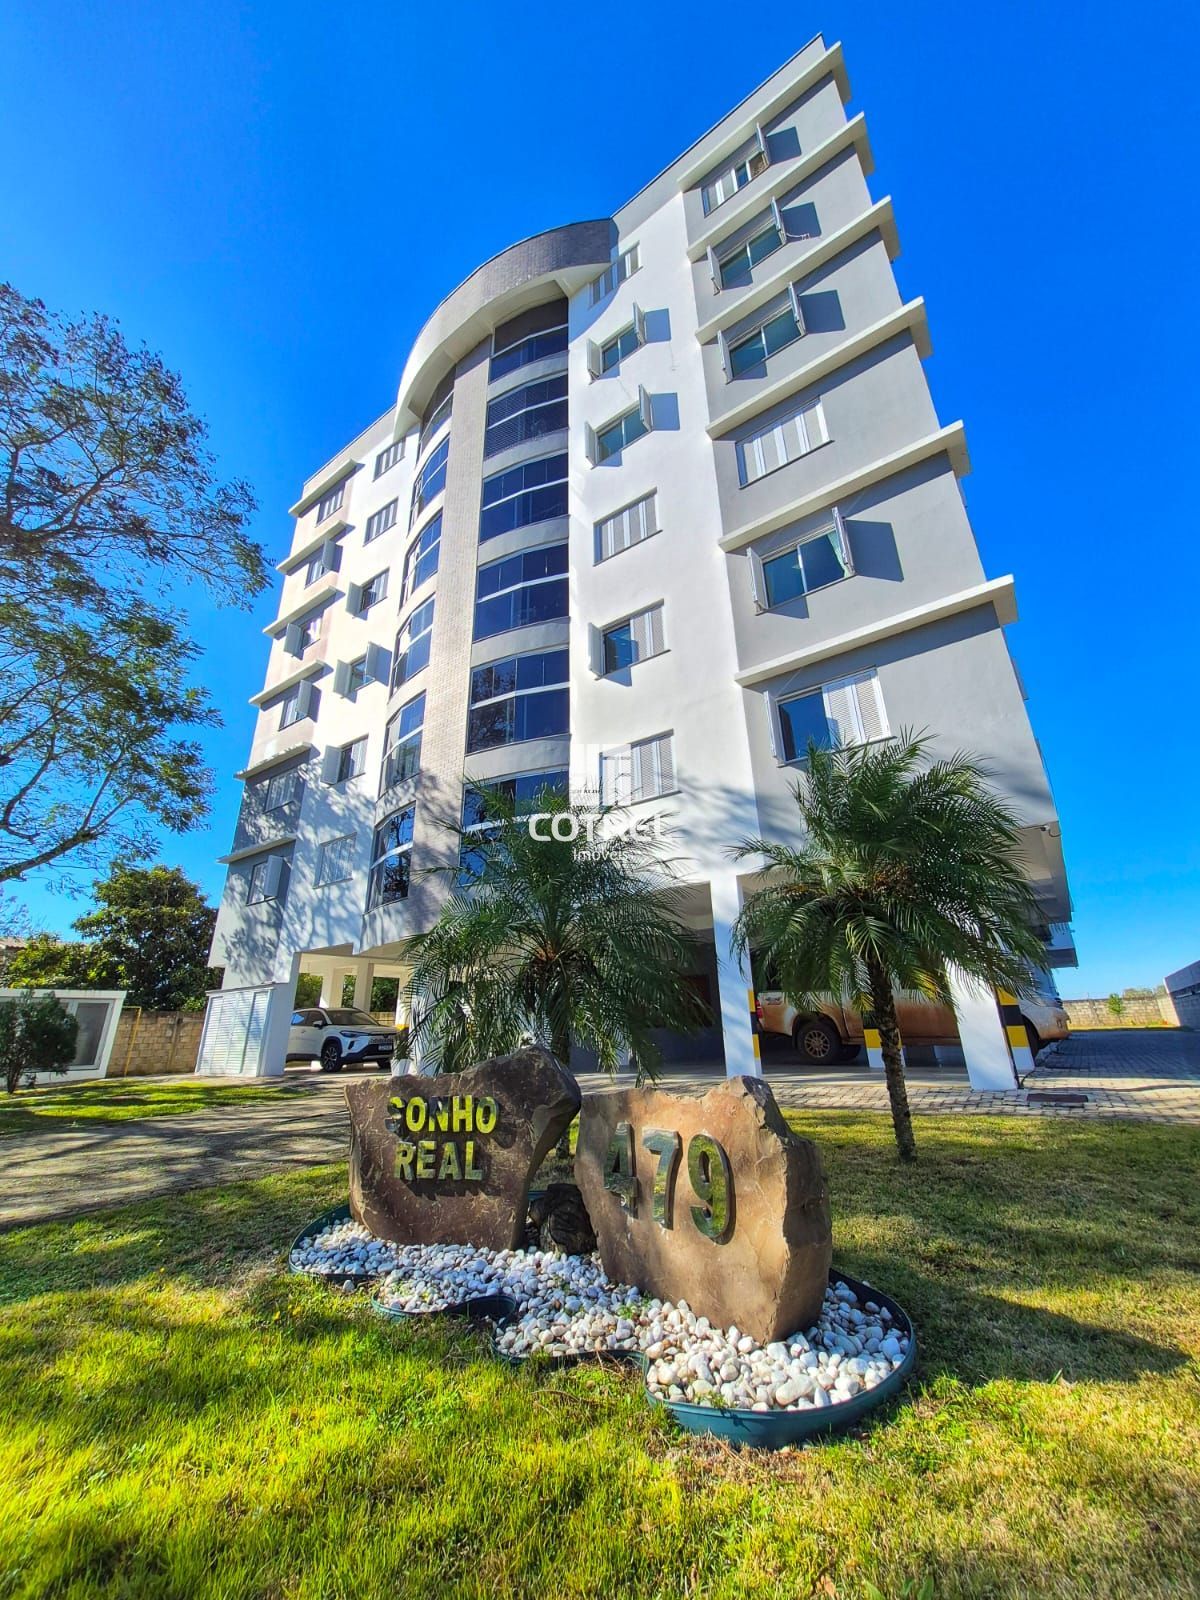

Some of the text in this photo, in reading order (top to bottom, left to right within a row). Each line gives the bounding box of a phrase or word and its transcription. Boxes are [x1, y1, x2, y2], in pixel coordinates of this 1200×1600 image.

[385, 1095, 497, 1134] SONHO
[394, 1140, 484, 1180] REAL
[603, 1122, 737, 1246] 479
